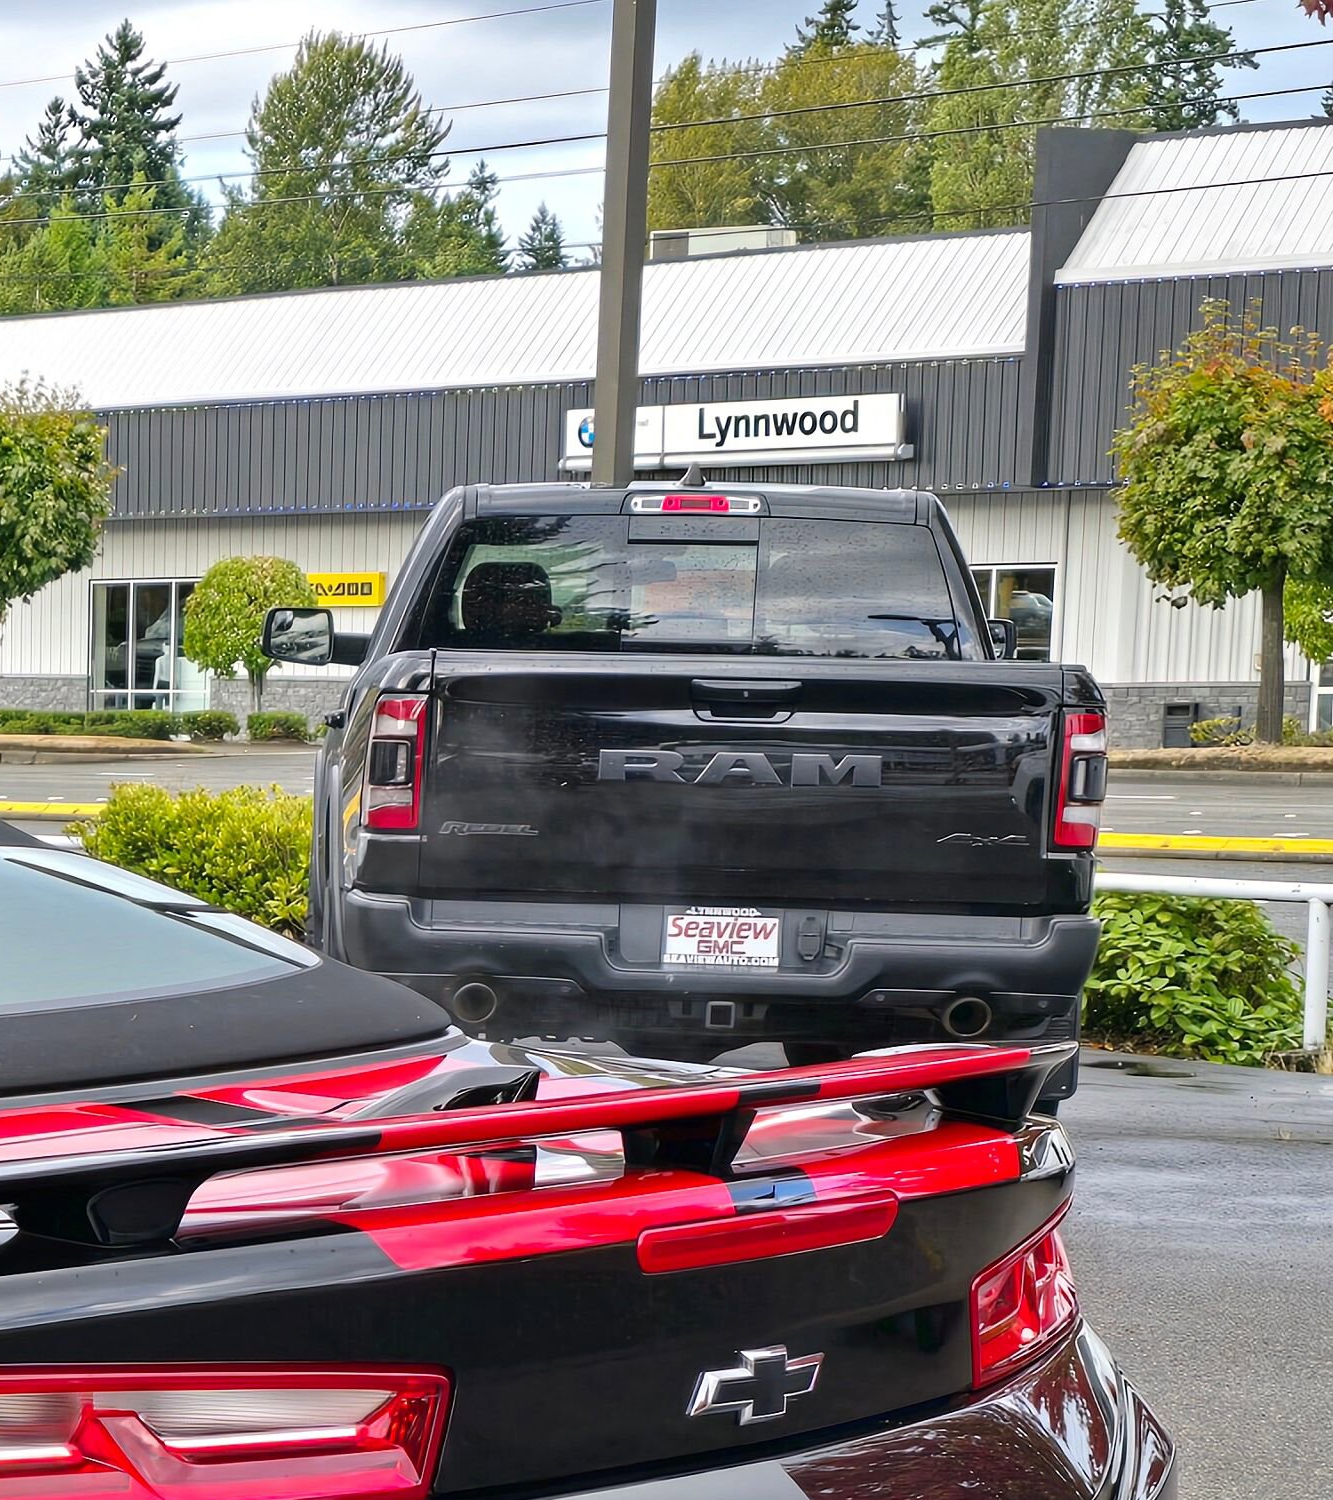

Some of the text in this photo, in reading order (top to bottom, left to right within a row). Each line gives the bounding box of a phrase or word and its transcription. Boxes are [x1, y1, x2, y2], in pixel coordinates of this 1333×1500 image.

[698, 399, 859, 447] Lynnwood
[597, 749, 882, 787] RAM
[668, 917, 777, 940] Seaview
[697, 939, 746, 954] GMC
